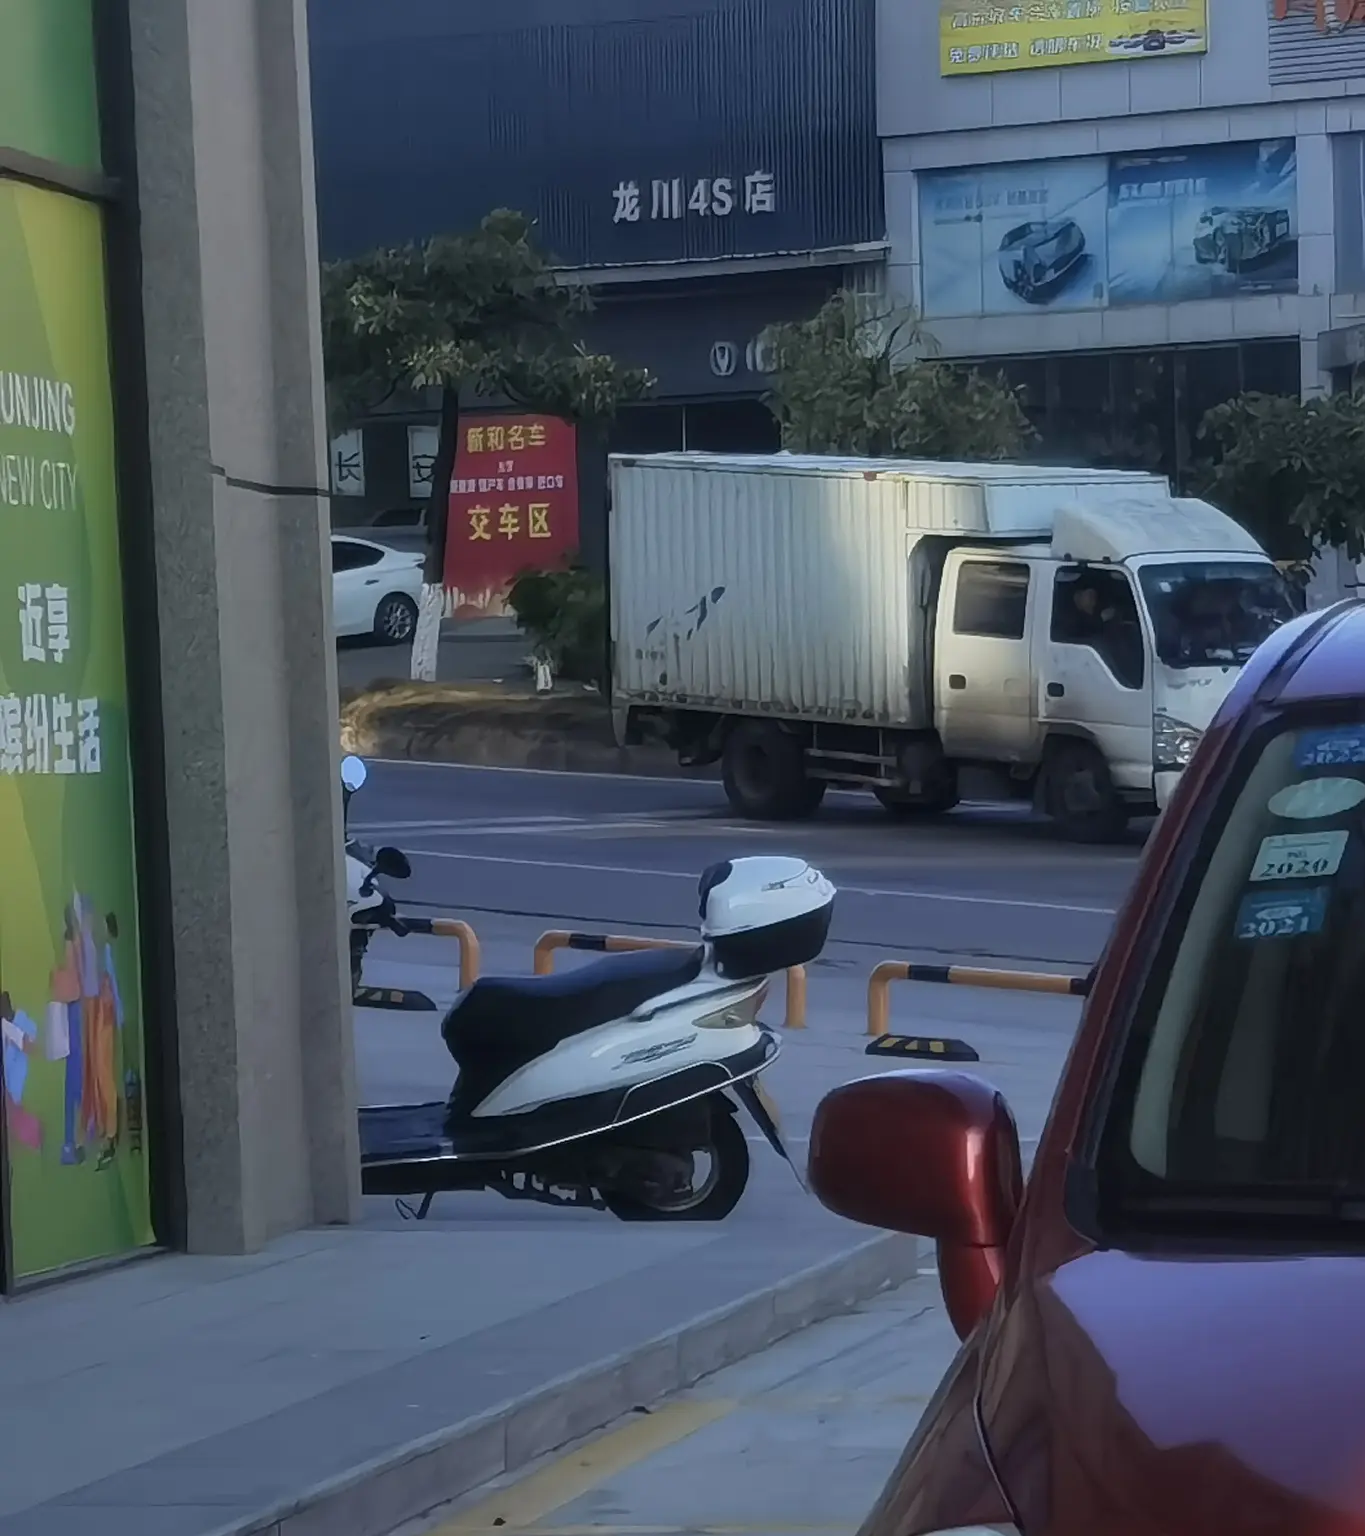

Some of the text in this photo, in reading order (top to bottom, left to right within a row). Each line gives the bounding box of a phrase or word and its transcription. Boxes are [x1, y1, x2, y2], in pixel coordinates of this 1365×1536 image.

[612, 170, 777, 224] 龙川4S店
[40, 459, 78, 511] CITY
[467, 502, 551, 541] 交车区
[1260, 859, 1330, 878] 2020
